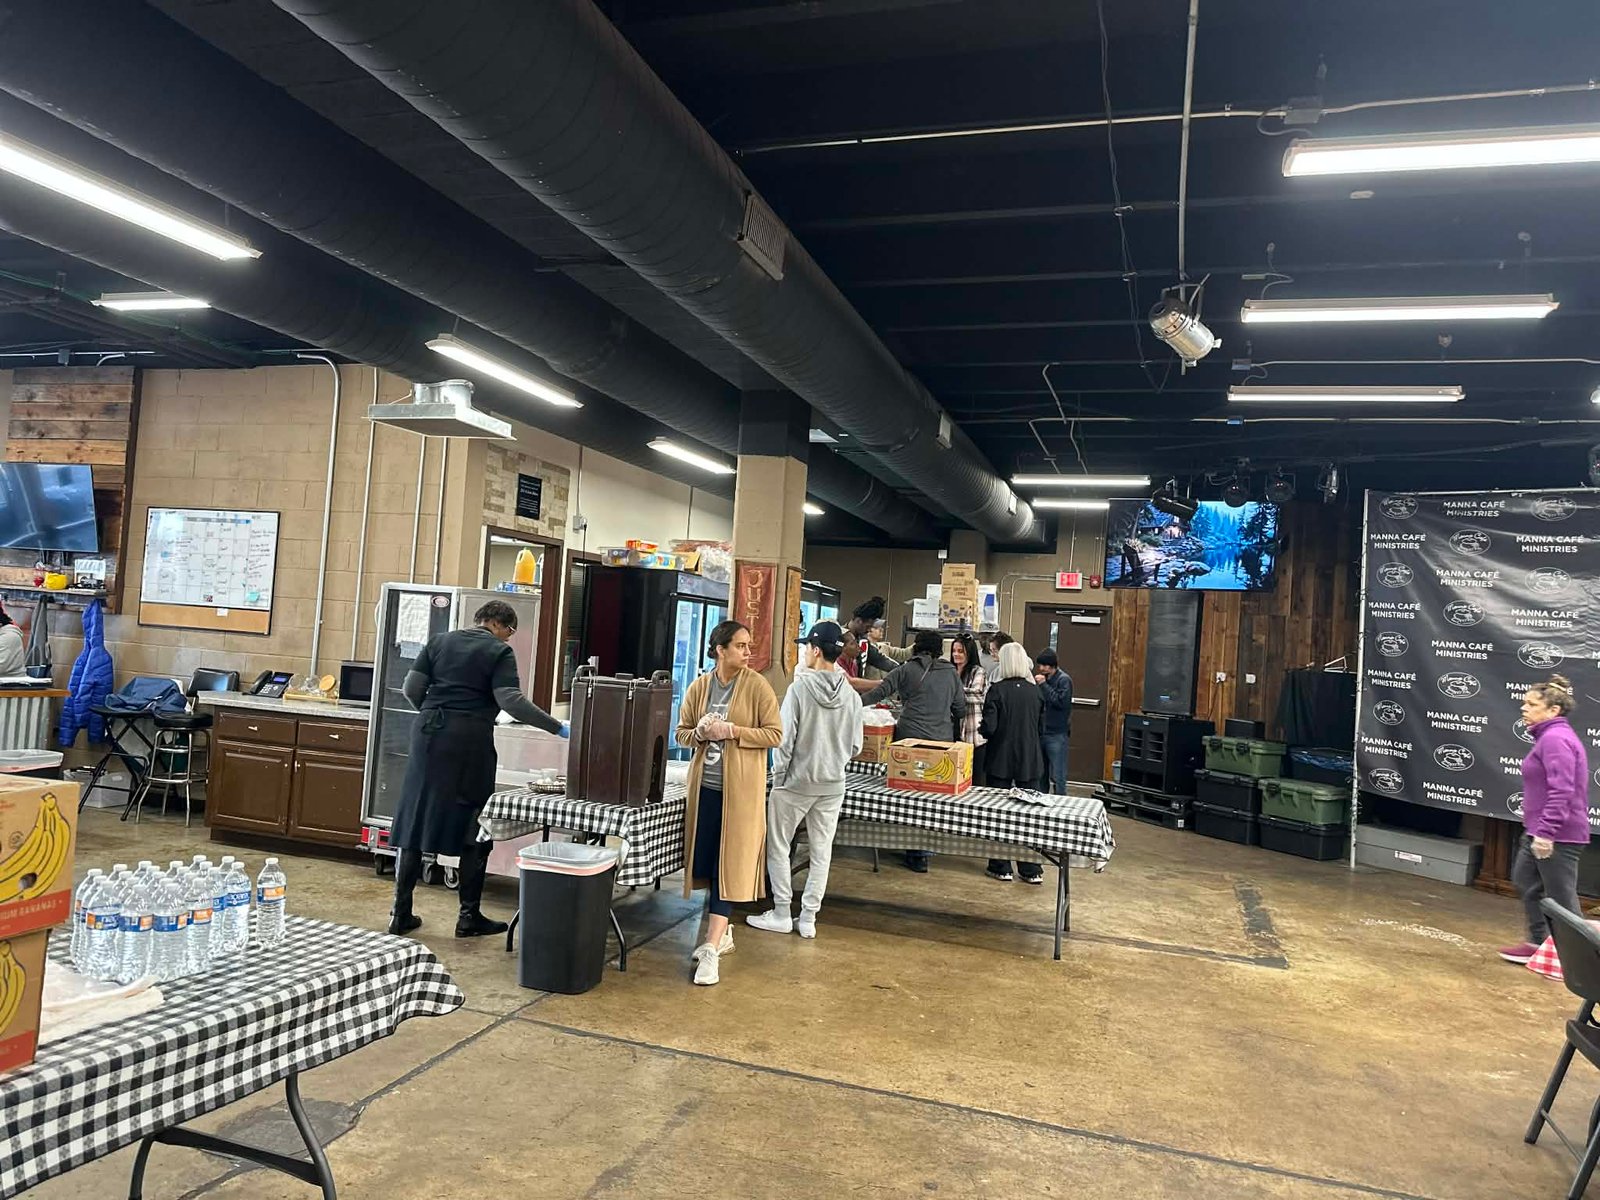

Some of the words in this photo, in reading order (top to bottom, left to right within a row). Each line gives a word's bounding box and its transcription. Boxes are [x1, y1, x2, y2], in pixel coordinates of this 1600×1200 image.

[1444, 501, 1477, 509] MANNA
[1480, 501, 1505, 509] CAFÉ
[1402, 533, 1426, 541] CAFÉ
[1516, 535, 1551, 543] MANNA
[1436, 569, 1470, 578] MANNA
[1060, 573, 1078, 586] EXIT
[1440, 579, 1493, 587] MINISTRIES
[1368, 602, 1395, 610] MANNA
[1371, 610, 1414, 619] MINISTRIES
[1511, 609, 1548, 618] MANNA
[1552, 610, 1579, 618] CAFÉ
[1516, 619, 1572, 628] MINISTRIES
[1432, 640, 1466, 650] MANNA
[1469, 642, 1493, 651] CAFÉ
[1436, 649, 1488, 660] MINISTRIES
[1368, 669, 1392, 678] MANNA
[1395, 672, 1416, 680] CAFÉ
[1371, 679, 1411, 689] MINISTRIES
[1427, 711, 1460, 721] MANNA
[1463, 715, 1488, 724] CAFÉ
[1431, 721, 1482, 732] MINISTRIES
[1361, 736, 1392, 746] MANNA
[1394, 742, 1412, 751] CAFÉ
[1365, 746, 1407, 759] MINISTRIES
[1500, 757, 1523, 765] MAN
[1423, 782, 1455, 793] MANNA
[1458, 788, 1483, 798] CAFÉ
[1427, 792, 1477, 806] MINISTRIES
